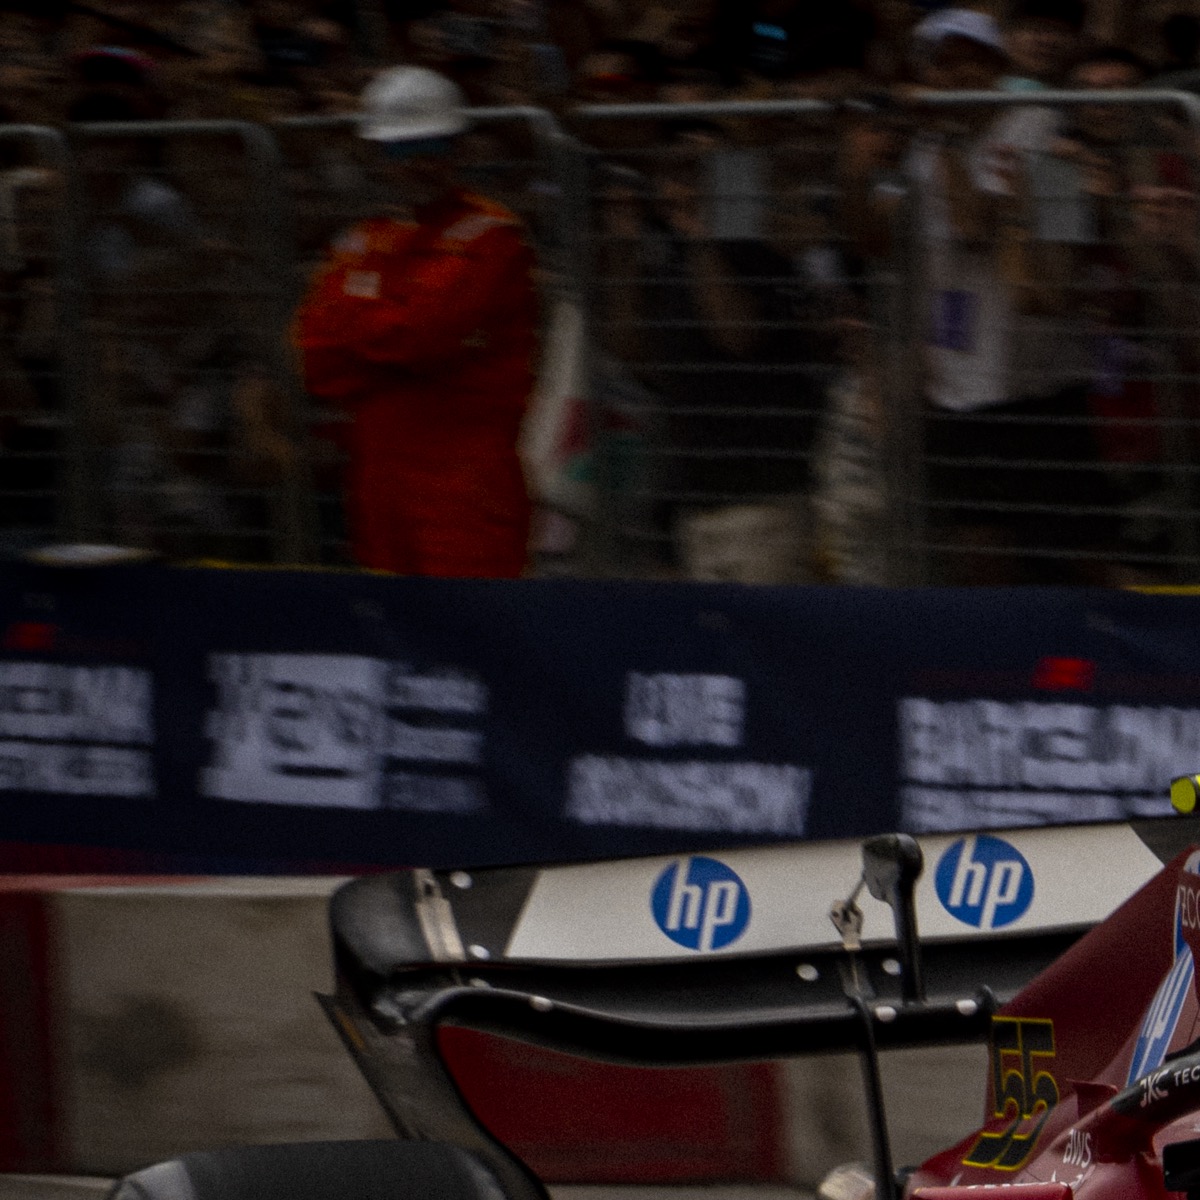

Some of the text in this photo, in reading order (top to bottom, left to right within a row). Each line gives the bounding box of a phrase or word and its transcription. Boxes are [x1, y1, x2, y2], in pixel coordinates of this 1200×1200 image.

[664, 857, 742, 950] hp
[949, 834, 1023, 929] hp
[962, 1014, 1061, 1171] 55
